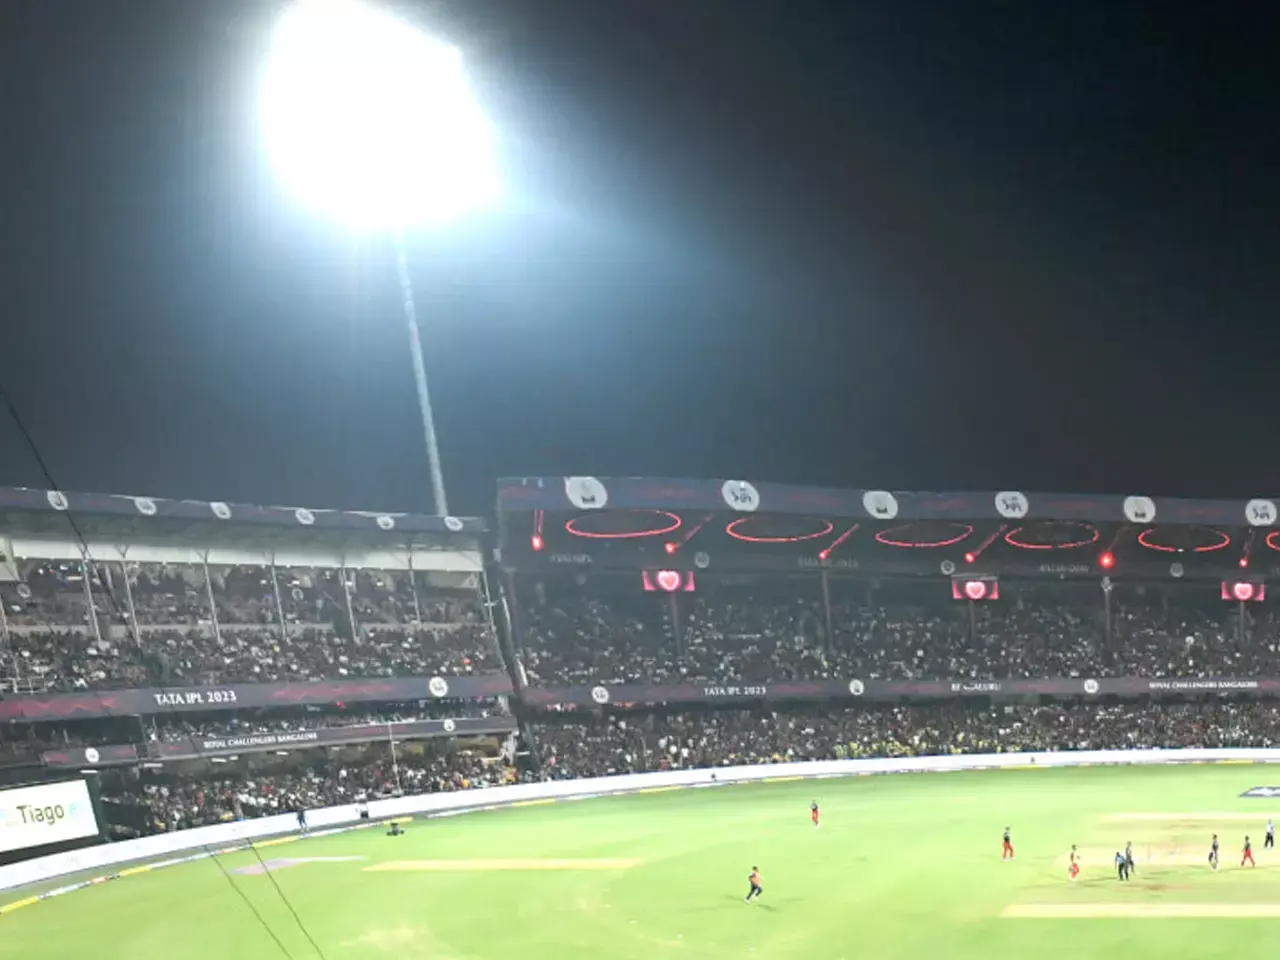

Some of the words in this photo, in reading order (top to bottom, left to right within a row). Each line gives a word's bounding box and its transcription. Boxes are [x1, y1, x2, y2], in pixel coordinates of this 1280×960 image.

[154, 692, 185, 706] TATA
[185, 691, 204, 704] IPL
[207, 690, 237, 703] 2023
[16, 804, 65, 826] Tiago
